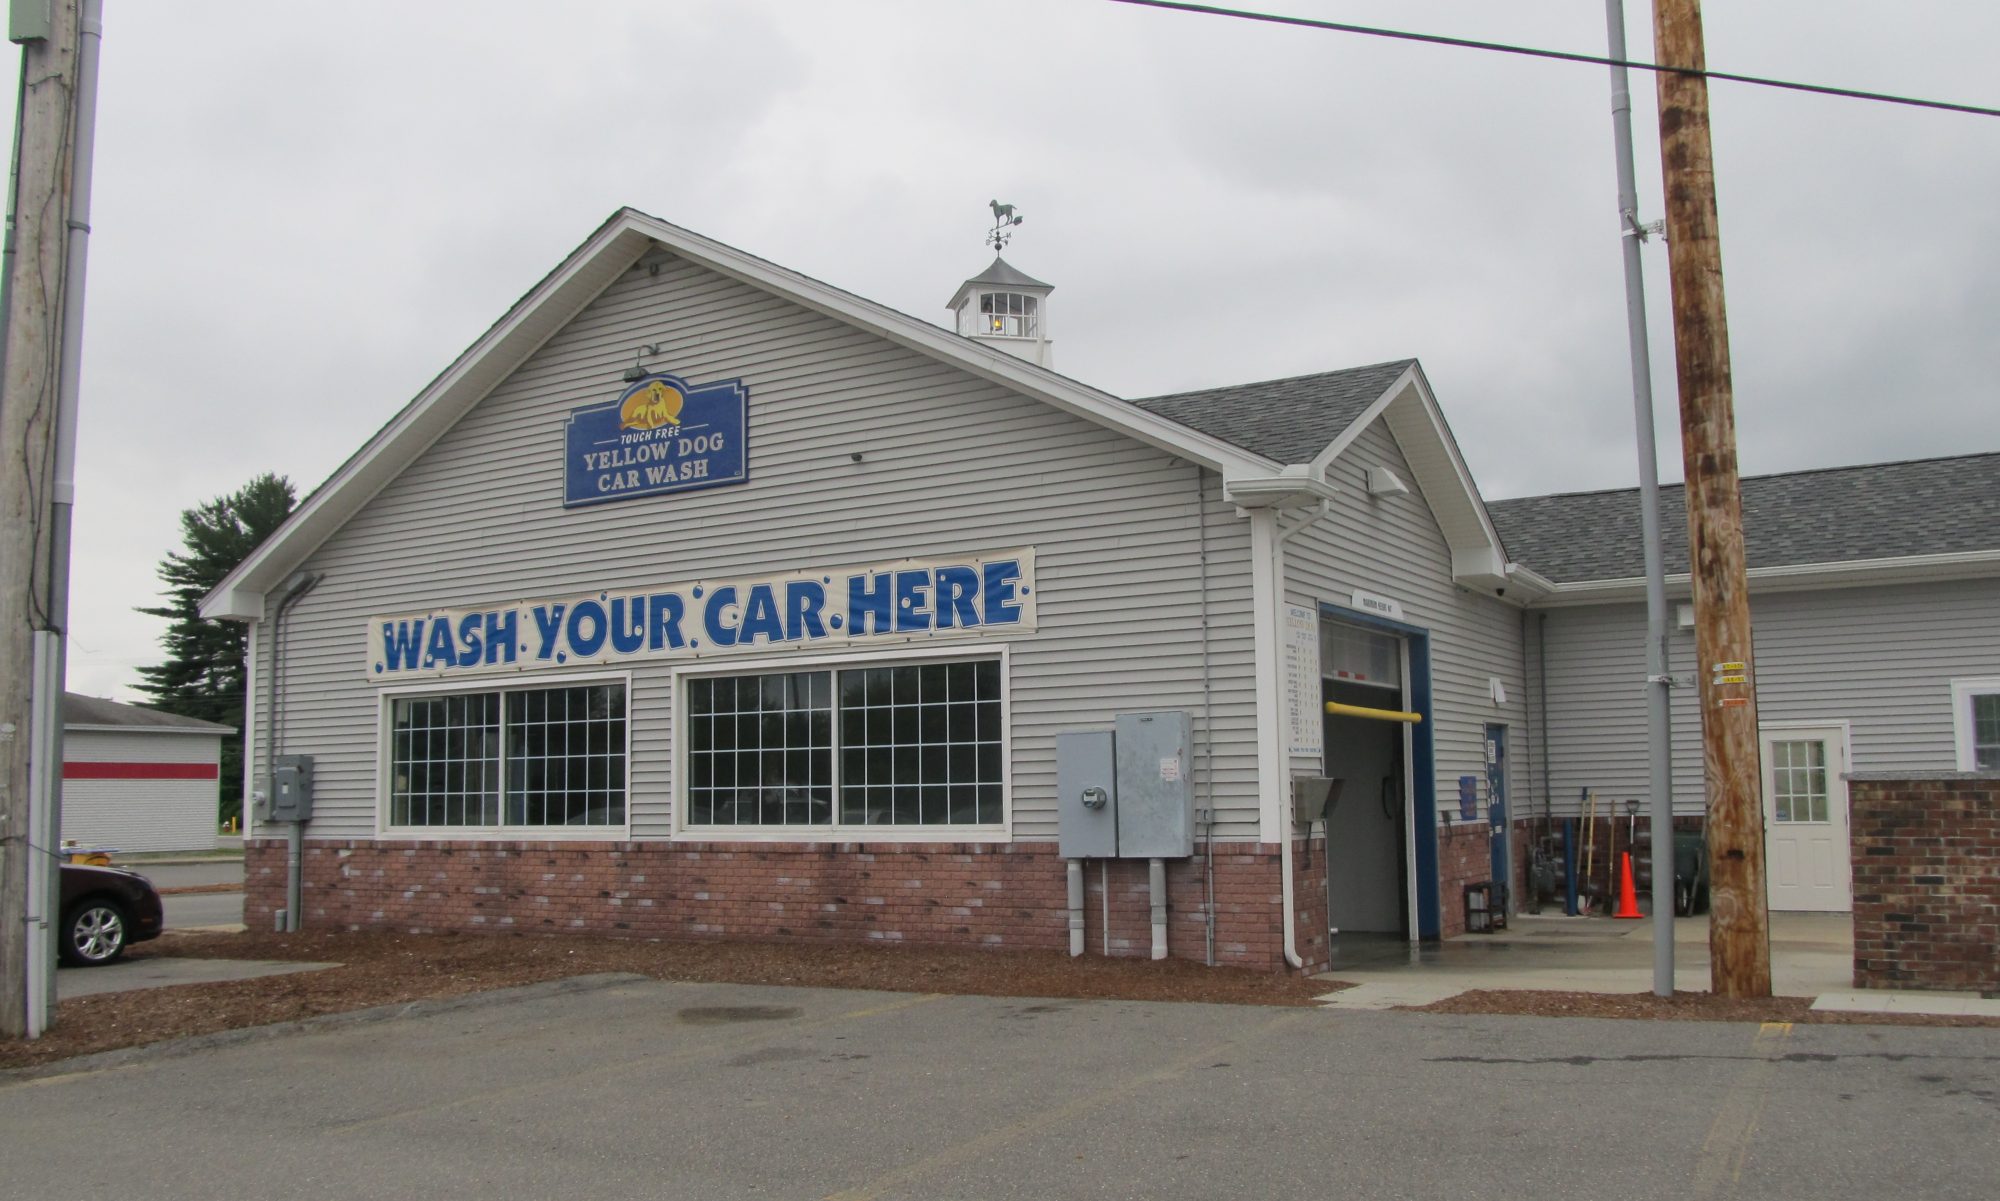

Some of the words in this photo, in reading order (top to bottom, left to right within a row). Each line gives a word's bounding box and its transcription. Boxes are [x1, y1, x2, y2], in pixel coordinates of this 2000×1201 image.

[583, 440, 670, 471] YELLOW
[678, 432, 724, 457] DOG
[620, 430, 652, 445] TOUCH
[655, 425, 681, 439] FREE
[598, 471, 640, 492] CAR
[645, 458, 708, 485] WASH
[381, 608, 519, 672] WASH
[531, 591, 688, 662] YOUR
[703, 579, 830, 647] CAR
[846, 559, 1024, 638] HERE
